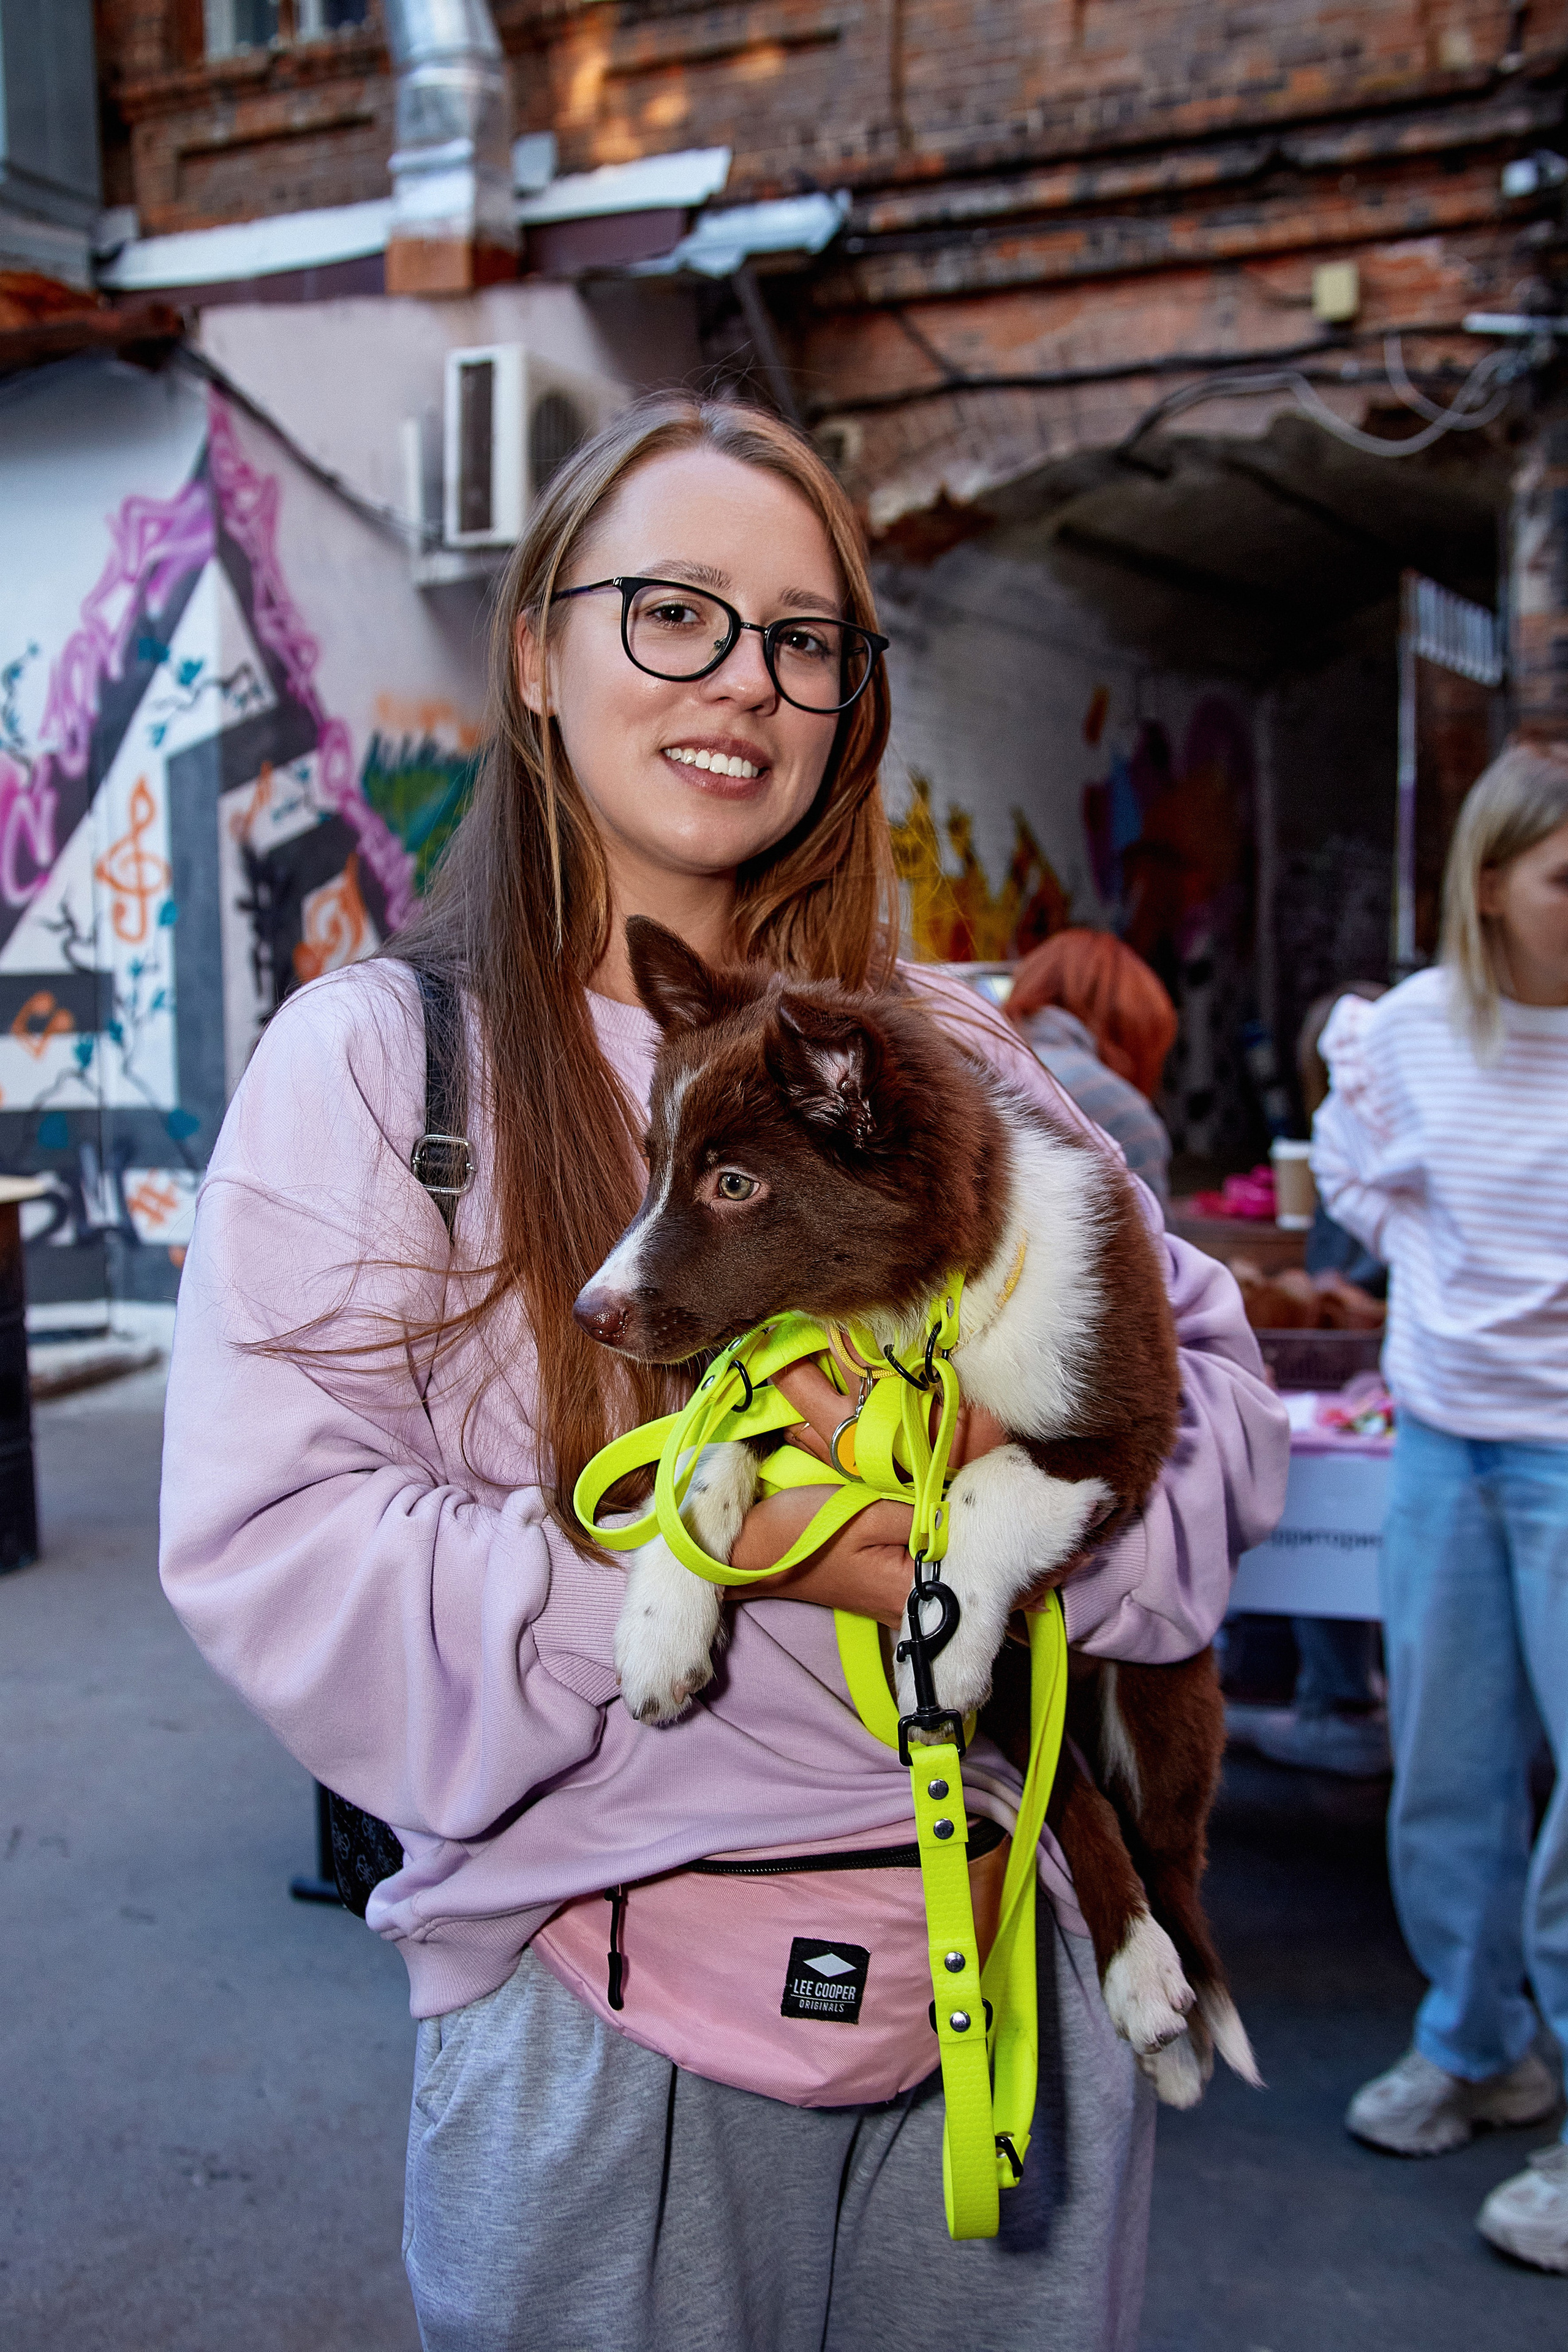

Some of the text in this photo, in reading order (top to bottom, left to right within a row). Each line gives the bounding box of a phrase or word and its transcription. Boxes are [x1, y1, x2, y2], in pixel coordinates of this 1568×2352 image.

[793, 1978, 856, 2000] LEE COOPER
[799, 1999, 844, 2013] ORIGINALS
